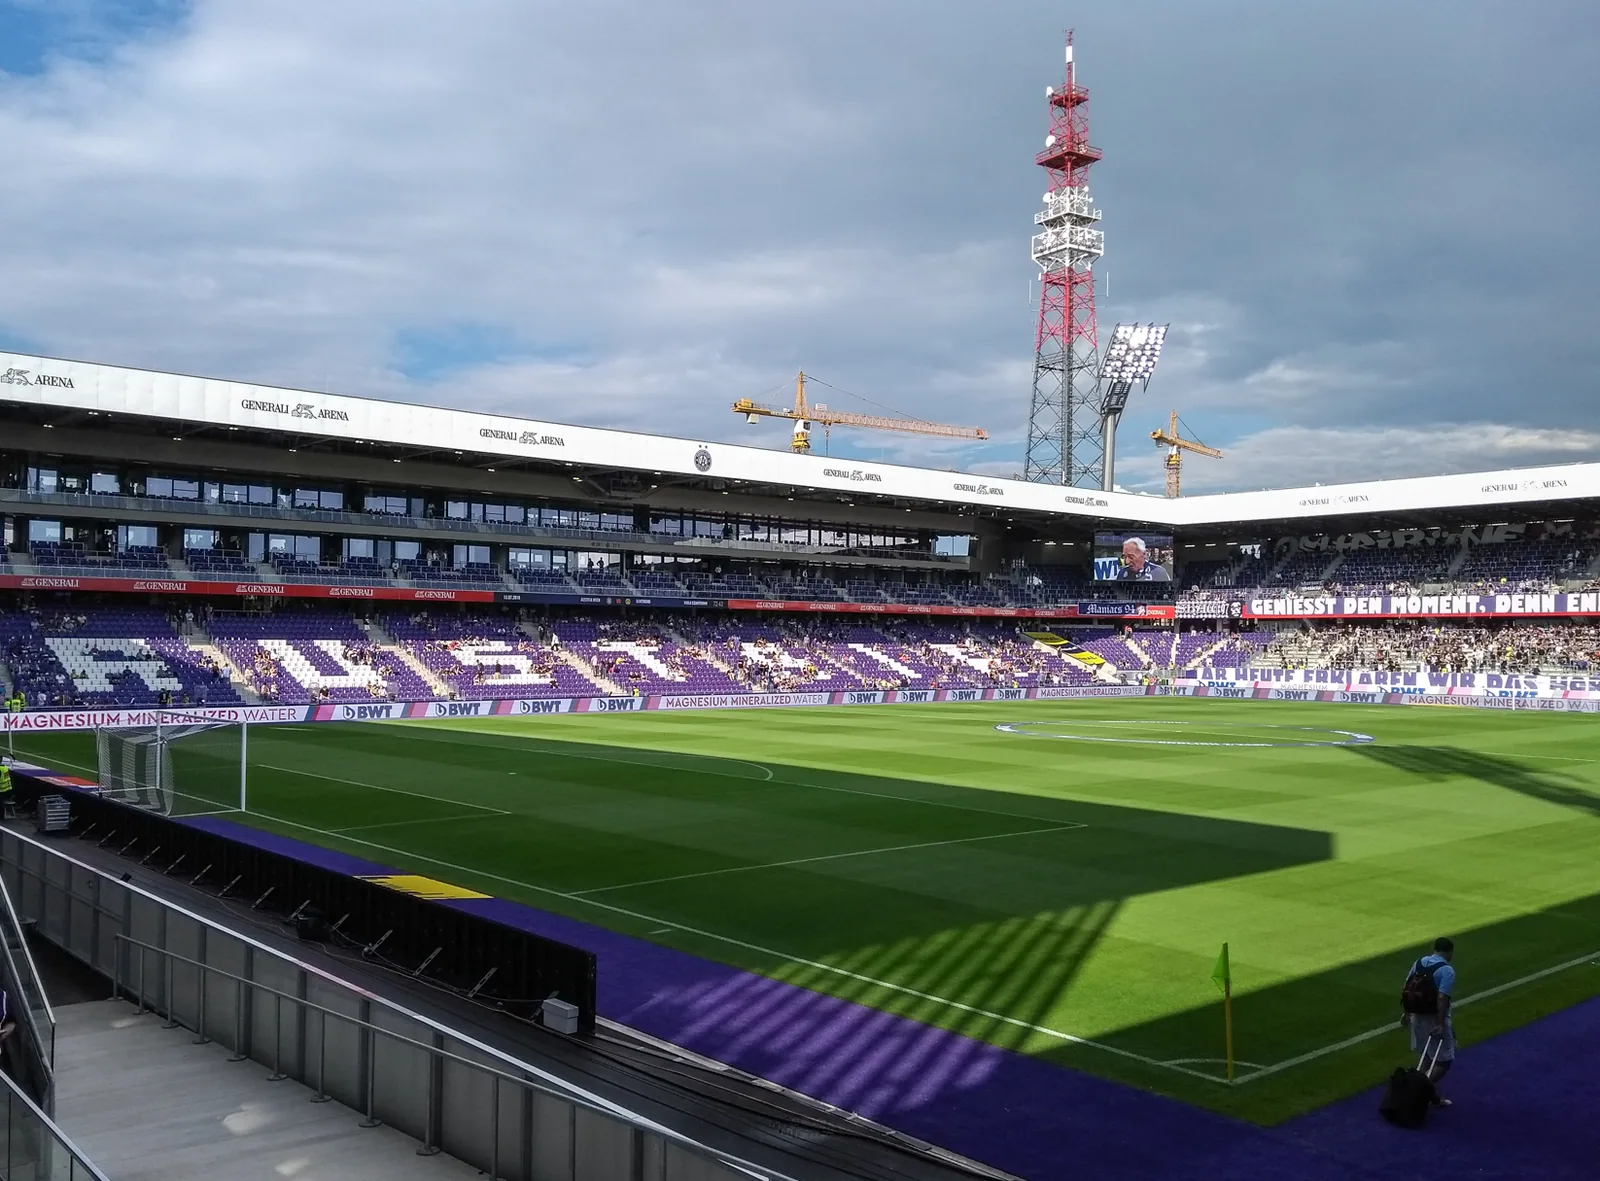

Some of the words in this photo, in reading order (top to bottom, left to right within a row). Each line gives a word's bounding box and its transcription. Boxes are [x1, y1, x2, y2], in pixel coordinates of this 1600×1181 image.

[35, 374, 75, 389] ARENA
[241, 399, 289, 414] GENERALI
[317, 408, 349, 421] ARENA
[479, 428, 517, 441] GENERALI
[540, 436, 565, 447] ARENA
[823, 468, 849, 479] GENERALI
[864, 473, 882, 482] ARENA
[953, 483, 976, 493] GENERALI
[1481, 484, 1518, 493] GENERALI
[35, 578, 79, 588] GENERALI
[147, 582, 187, 591] GENERALI
[247, 585, 284, 594] GENERALI
[340, 588, 374, 597] GENERALI
[424, 591, 456, 599] GENERALI
[1086, 603, 1122, 614] Maniacs
[1252, 599, 1336, 616] GENIESST
[1343, 597, 1382, 615] DEN
[1390, 596, 1489, 614] MOMENT,
[1495, 595, 1555, 613] DENN
[1427, 672, 1476, 688] WIR
[1486, 674, 1538, 690] DAS
[857, 693, 877, 703] BWT
[908, 691, 928, 701] BWT
[958, 690, 977, 700] BWT
[1003, 689, 1021, 699] BWT
[1040, 689, 1081, 698] MAGNESIUM
[1082, 687, 1121, 697] MINERALIZED
[1122, 687, 1143, 695] WATER
[1223, 689, 1246, 698] BWT
[1285, 691, 1309, 700] BWT
[1351, 693, 1377, 703] BWT
[529, 700, 562, 713] BWT
[607, 699, 635, 711] BWT
[666, 695, 728, 709] MAGNESIUM
[731, 694, 790, 706] MINERALIZED
[793, 694, 823, 704] WATER
[1408, 695, 1480, 706] MAGNESIUM
[1483, 699, 1564, 709] MINERALIZED
[358, 705, 393, 719] BWT
[447, 702, 481, 716] BWT
[4, 713, 120, 729] MAGNESIUM
[243, 709, 297, 721] WATER
